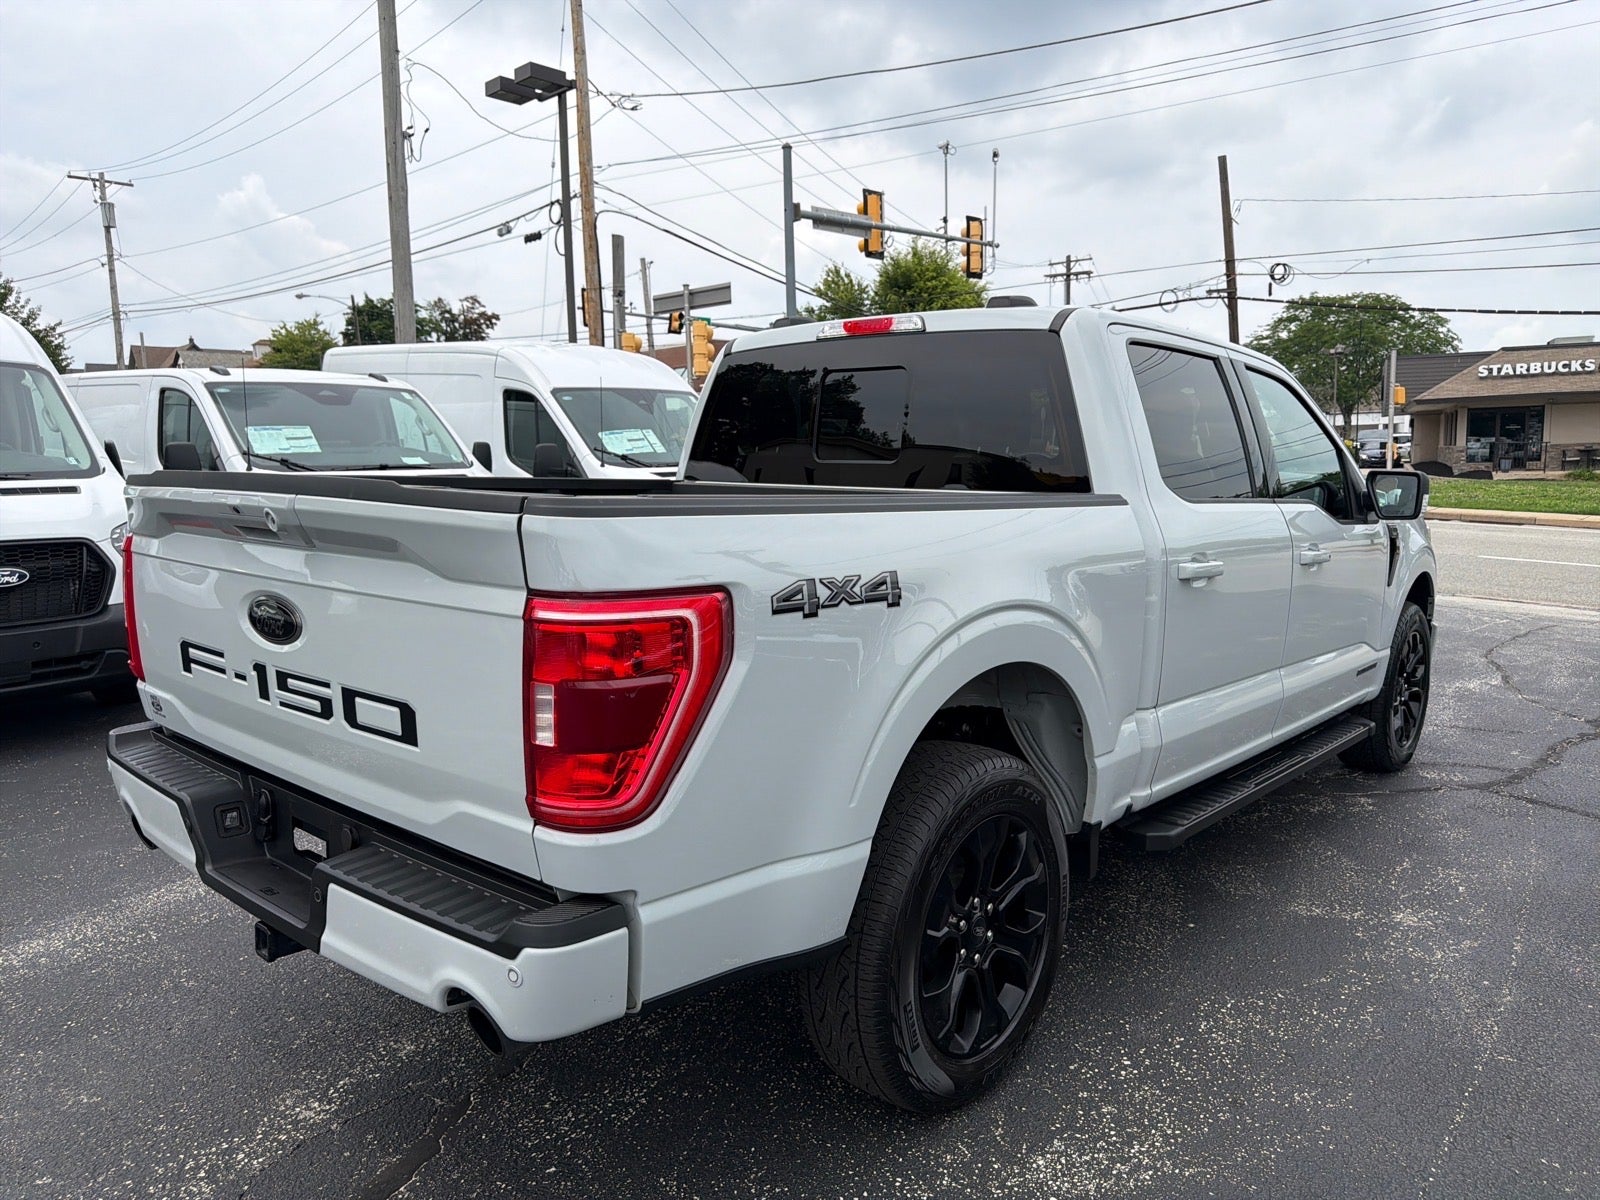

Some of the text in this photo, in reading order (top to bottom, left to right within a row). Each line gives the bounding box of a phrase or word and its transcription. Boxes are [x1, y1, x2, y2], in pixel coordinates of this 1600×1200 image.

[1478, 359, 1596, 377] STARBUCKS
[0, 571, 19, 583] ord
[180, 639, 419, 749] F-150
